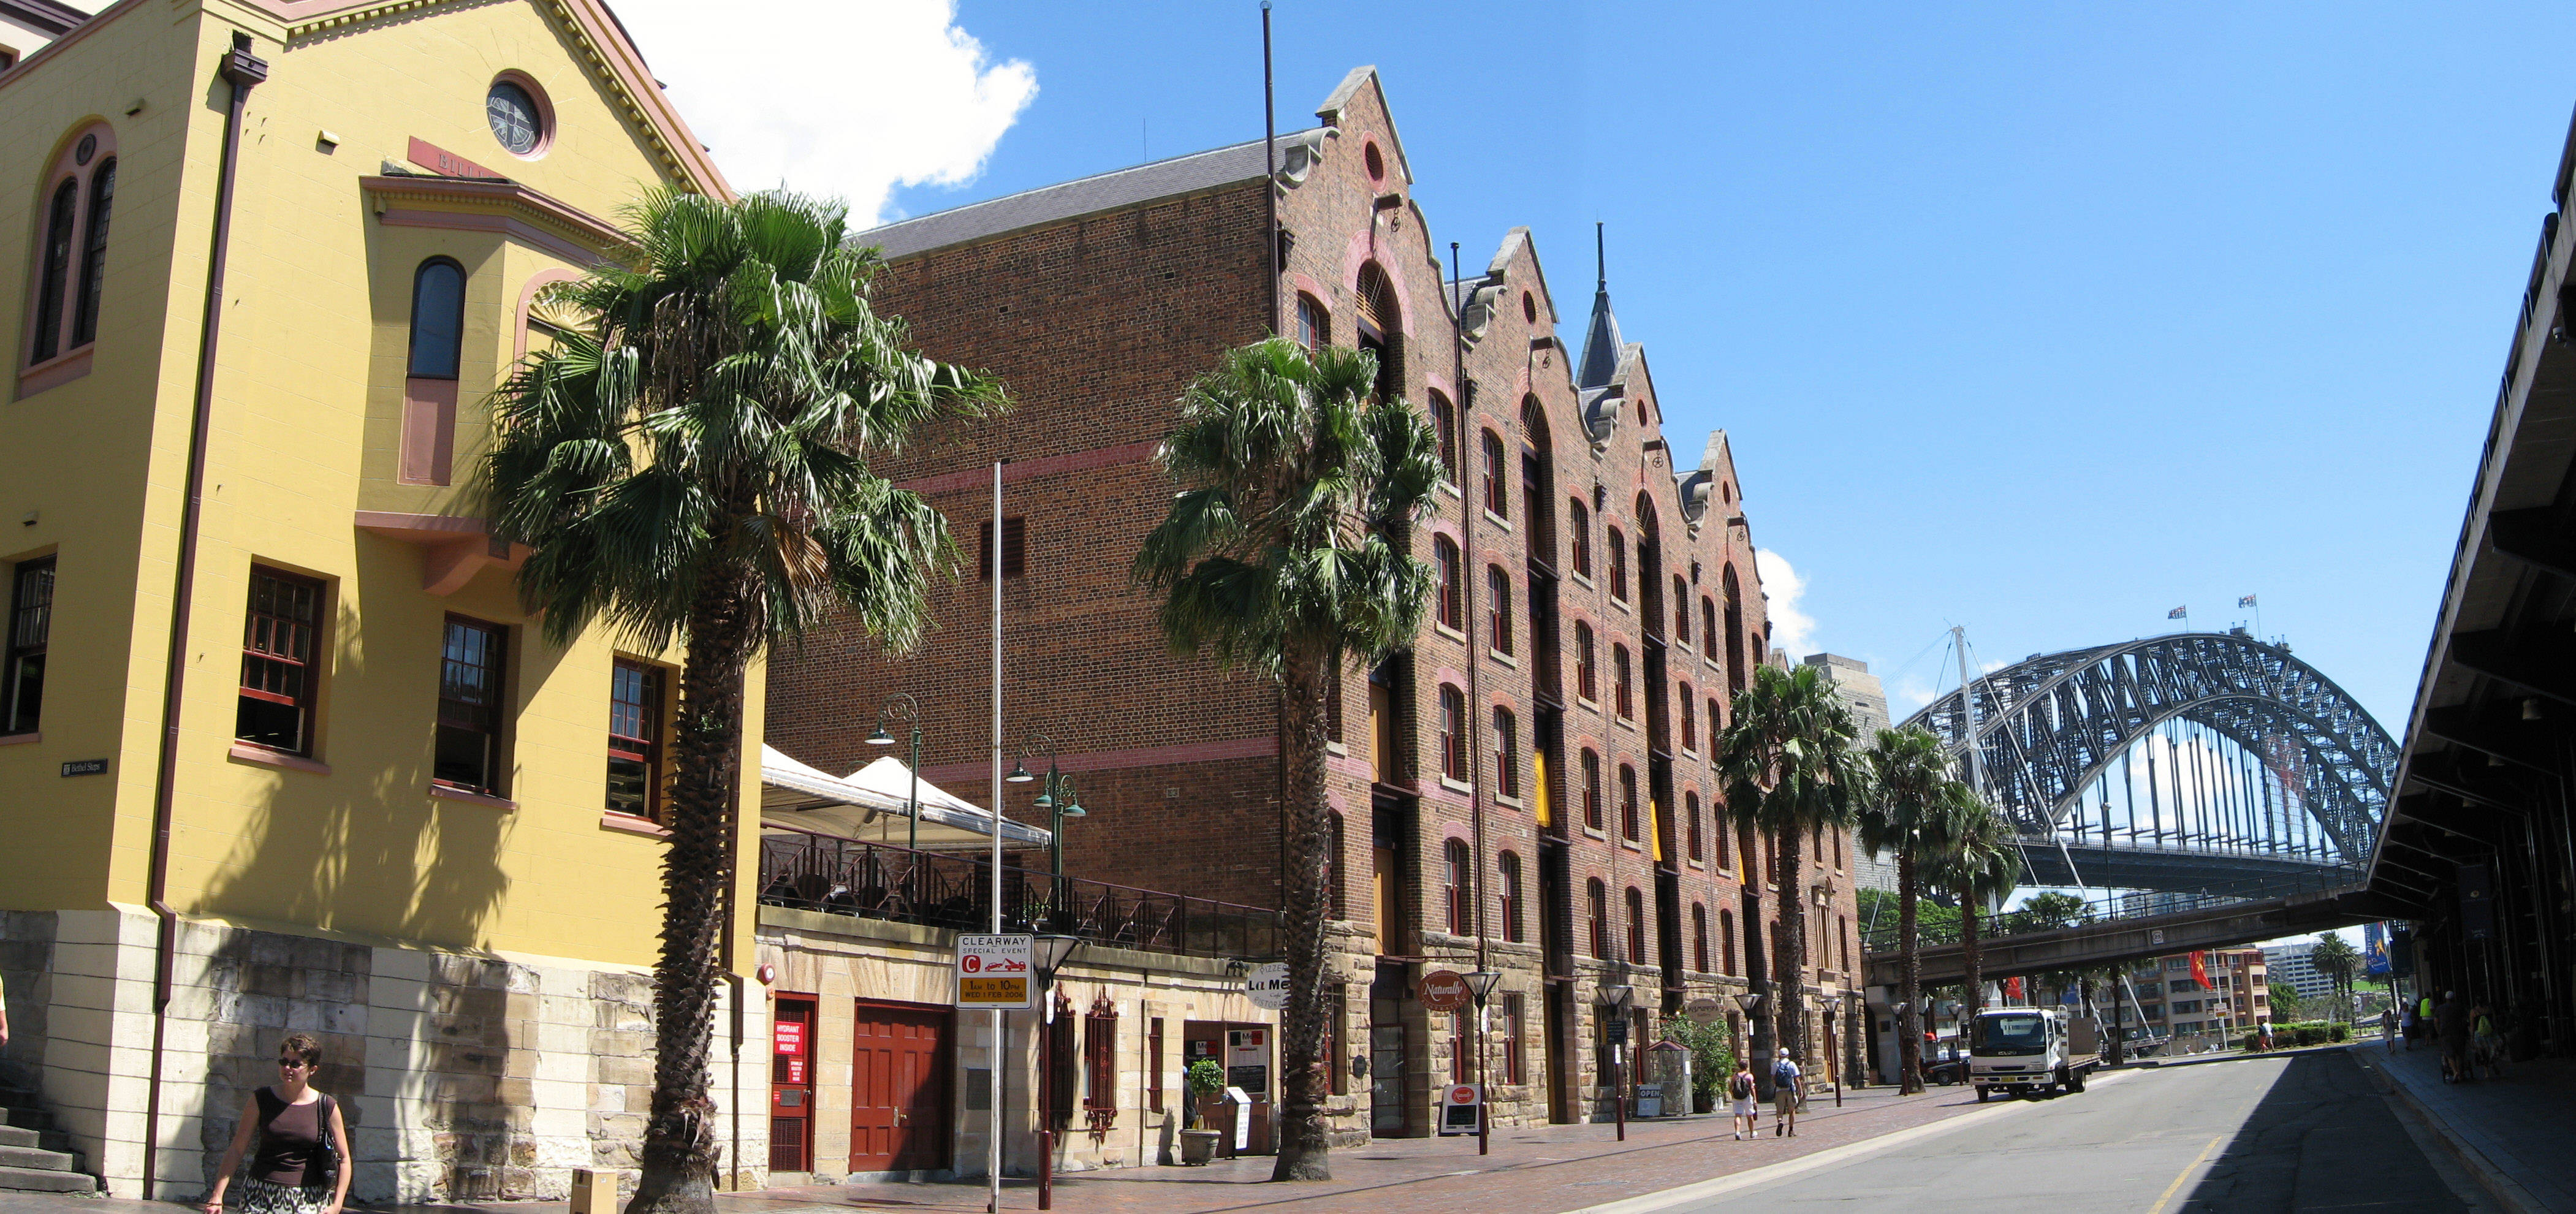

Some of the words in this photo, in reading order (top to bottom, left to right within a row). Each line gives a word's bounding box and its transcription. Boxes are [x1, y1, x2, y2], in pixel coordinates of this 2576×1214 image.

[87, 762, 101, 771] Steps
[966, 957, 977, 971] C
[1260, 965, 1287, 974] PIZZER
[1248, 981, 1265, 990] La
[1269, 979, 1290, 990] Me
[1424, 981, 1462, 1001] Naturally
[1255, 996, 1284, 1008] RISTORA
[777, 1024, 799, 1033] HYDRANT
[777, 1034, 799, 1042] BOOSTER
